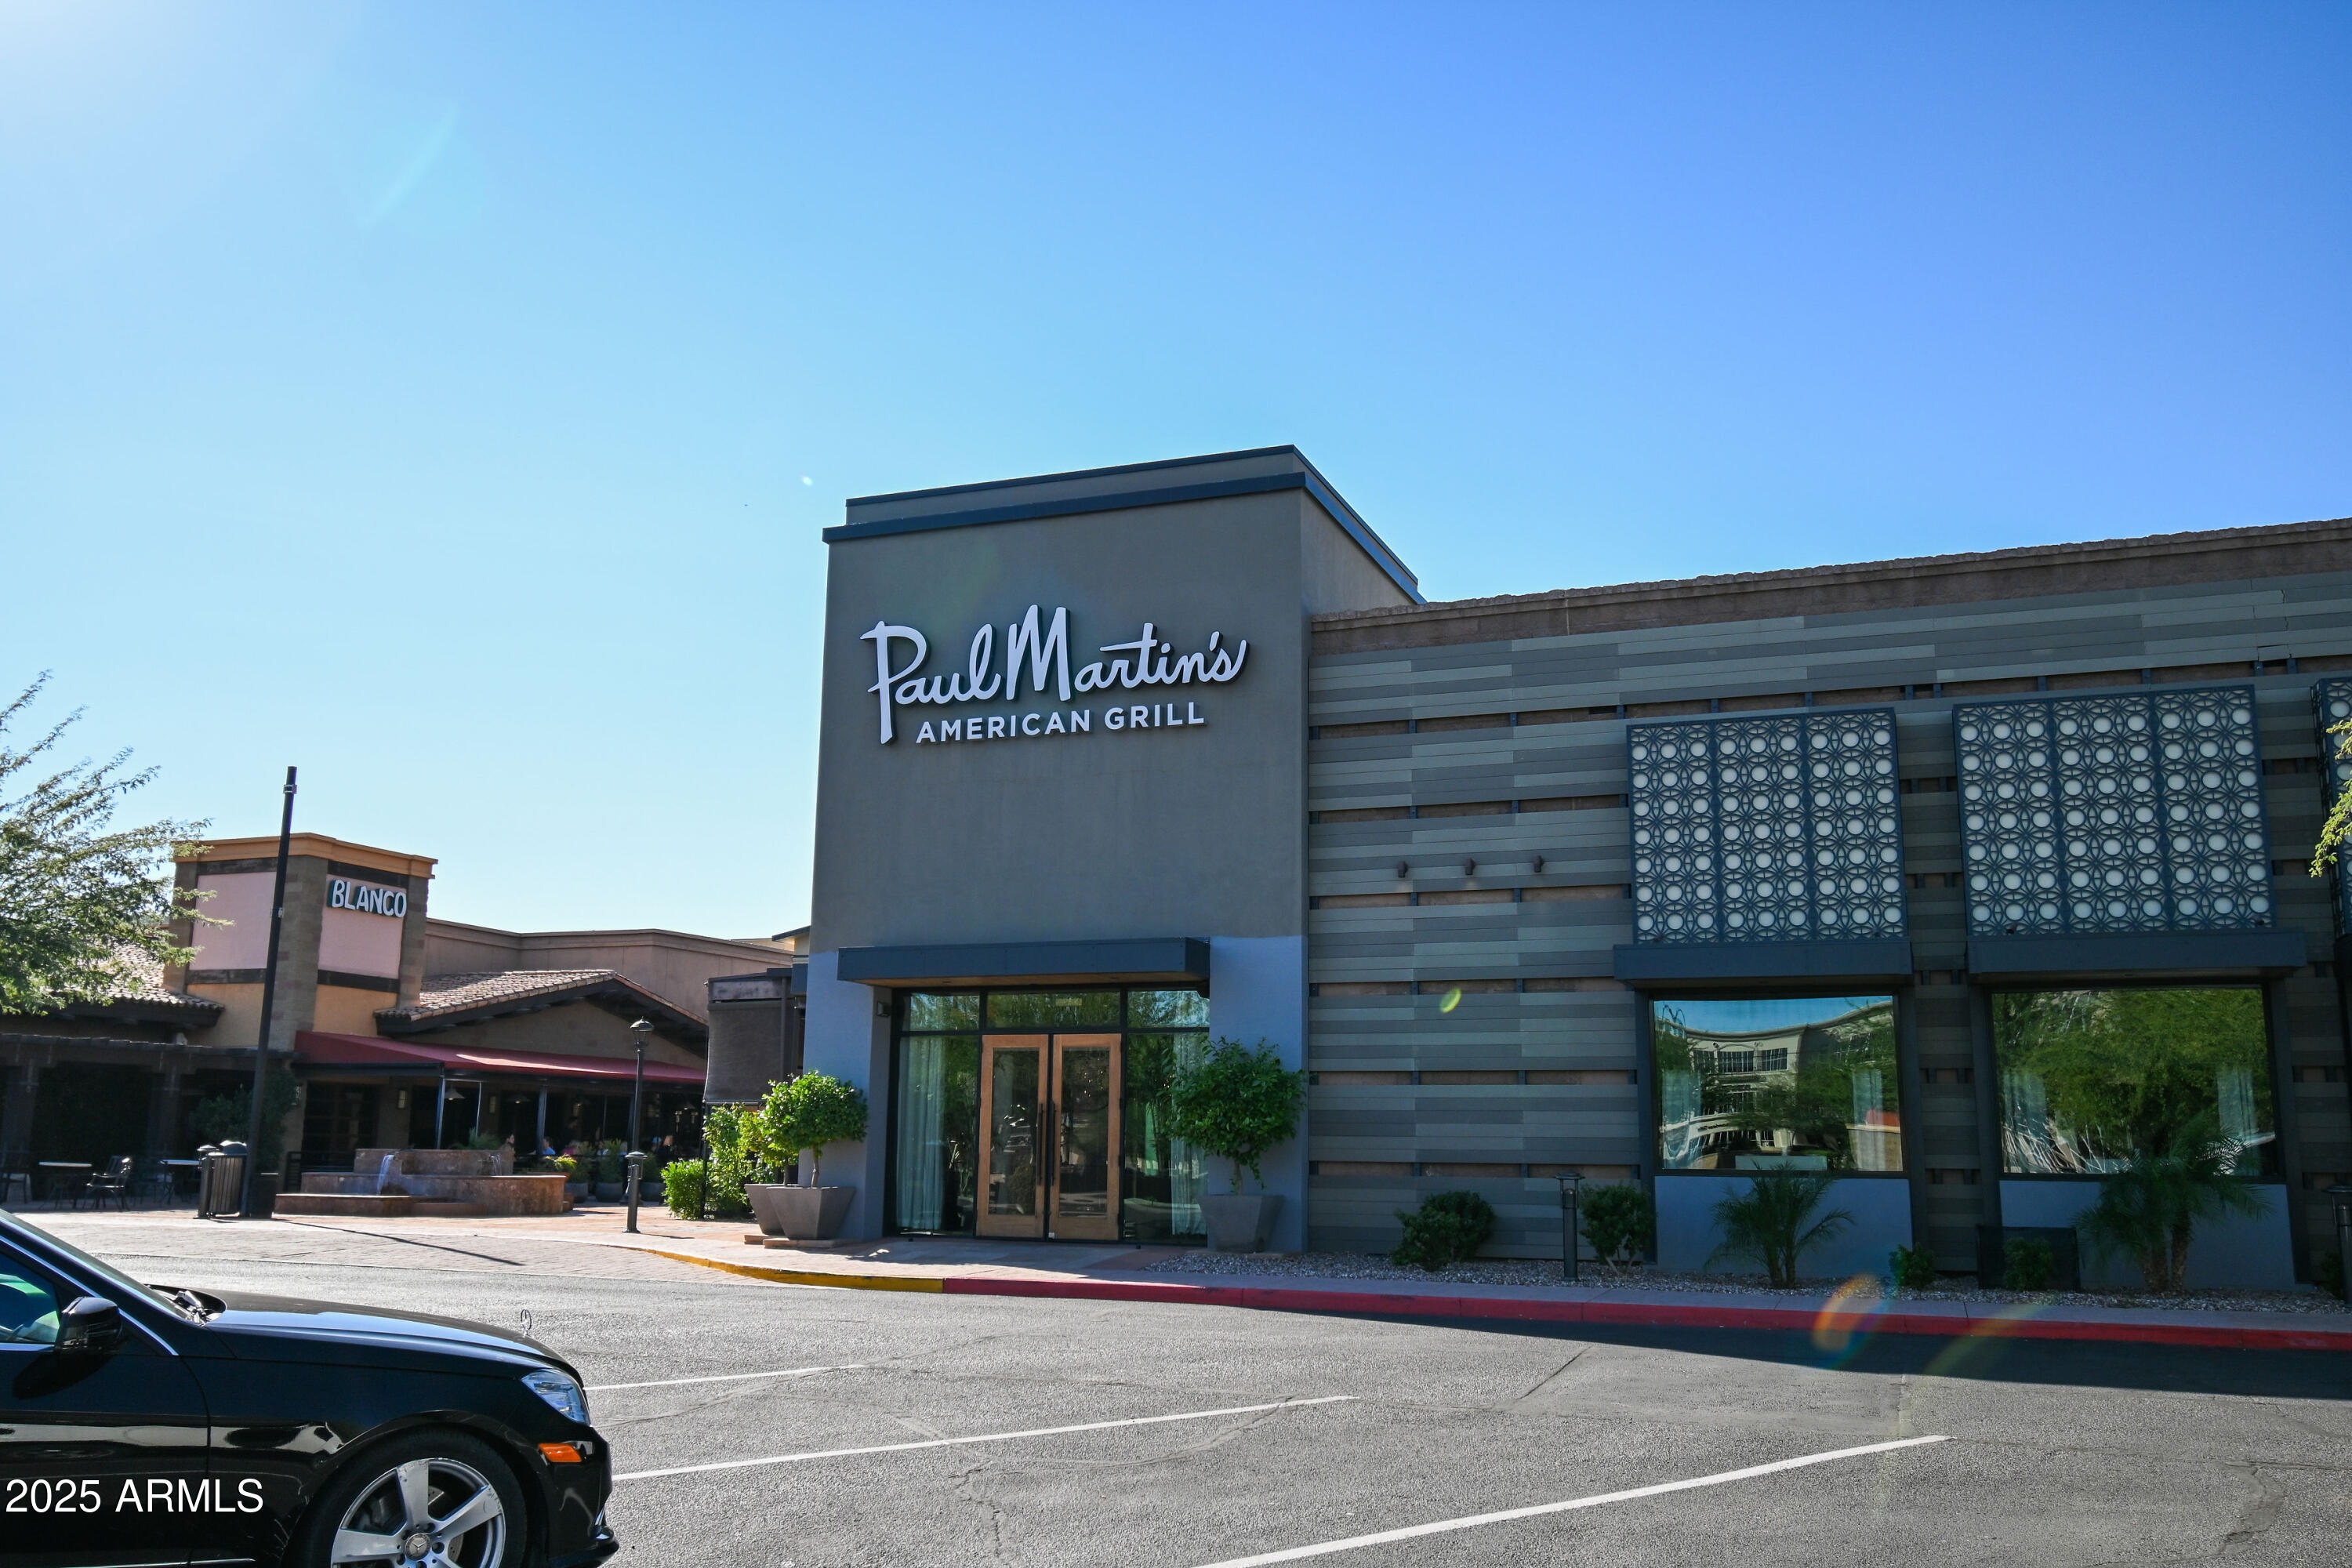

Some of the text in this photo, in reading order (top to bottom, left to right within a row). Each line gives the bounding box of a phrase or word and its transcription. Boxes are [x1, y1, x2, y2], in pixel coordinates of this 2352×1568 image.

[860, 604, 1249, 744] Paul Martin's
[916, 702, 1205, 744] AMERICAN GRILL
[330, 879, 408, 918] BLANCO
